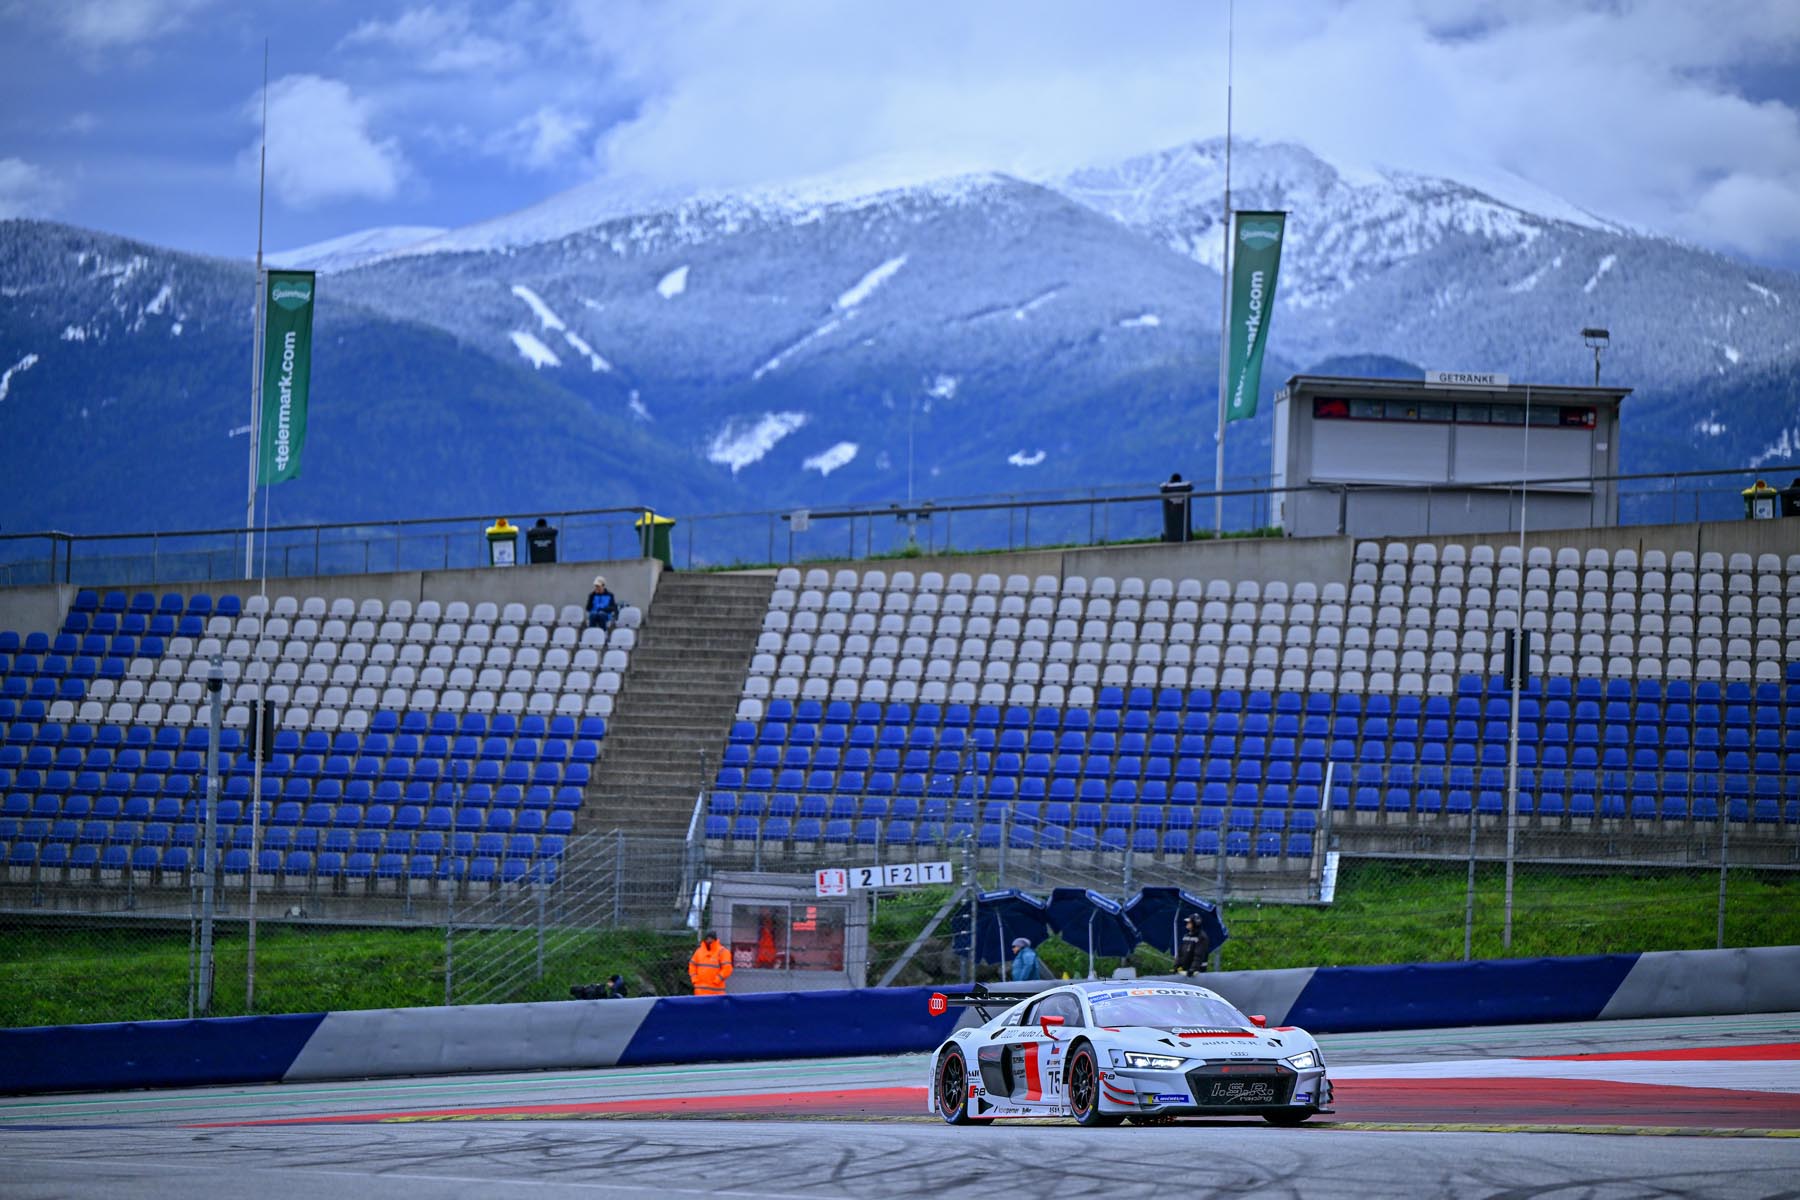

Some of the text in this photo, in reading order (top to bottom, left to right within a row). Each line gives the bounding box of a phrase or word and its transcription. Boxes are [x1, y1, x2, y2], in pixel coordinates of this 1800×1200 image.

[861, 869, 872, 886] 2
[974, 1087, 986, 1096] R8
[1048, 1071, 1061, 1095] 75
